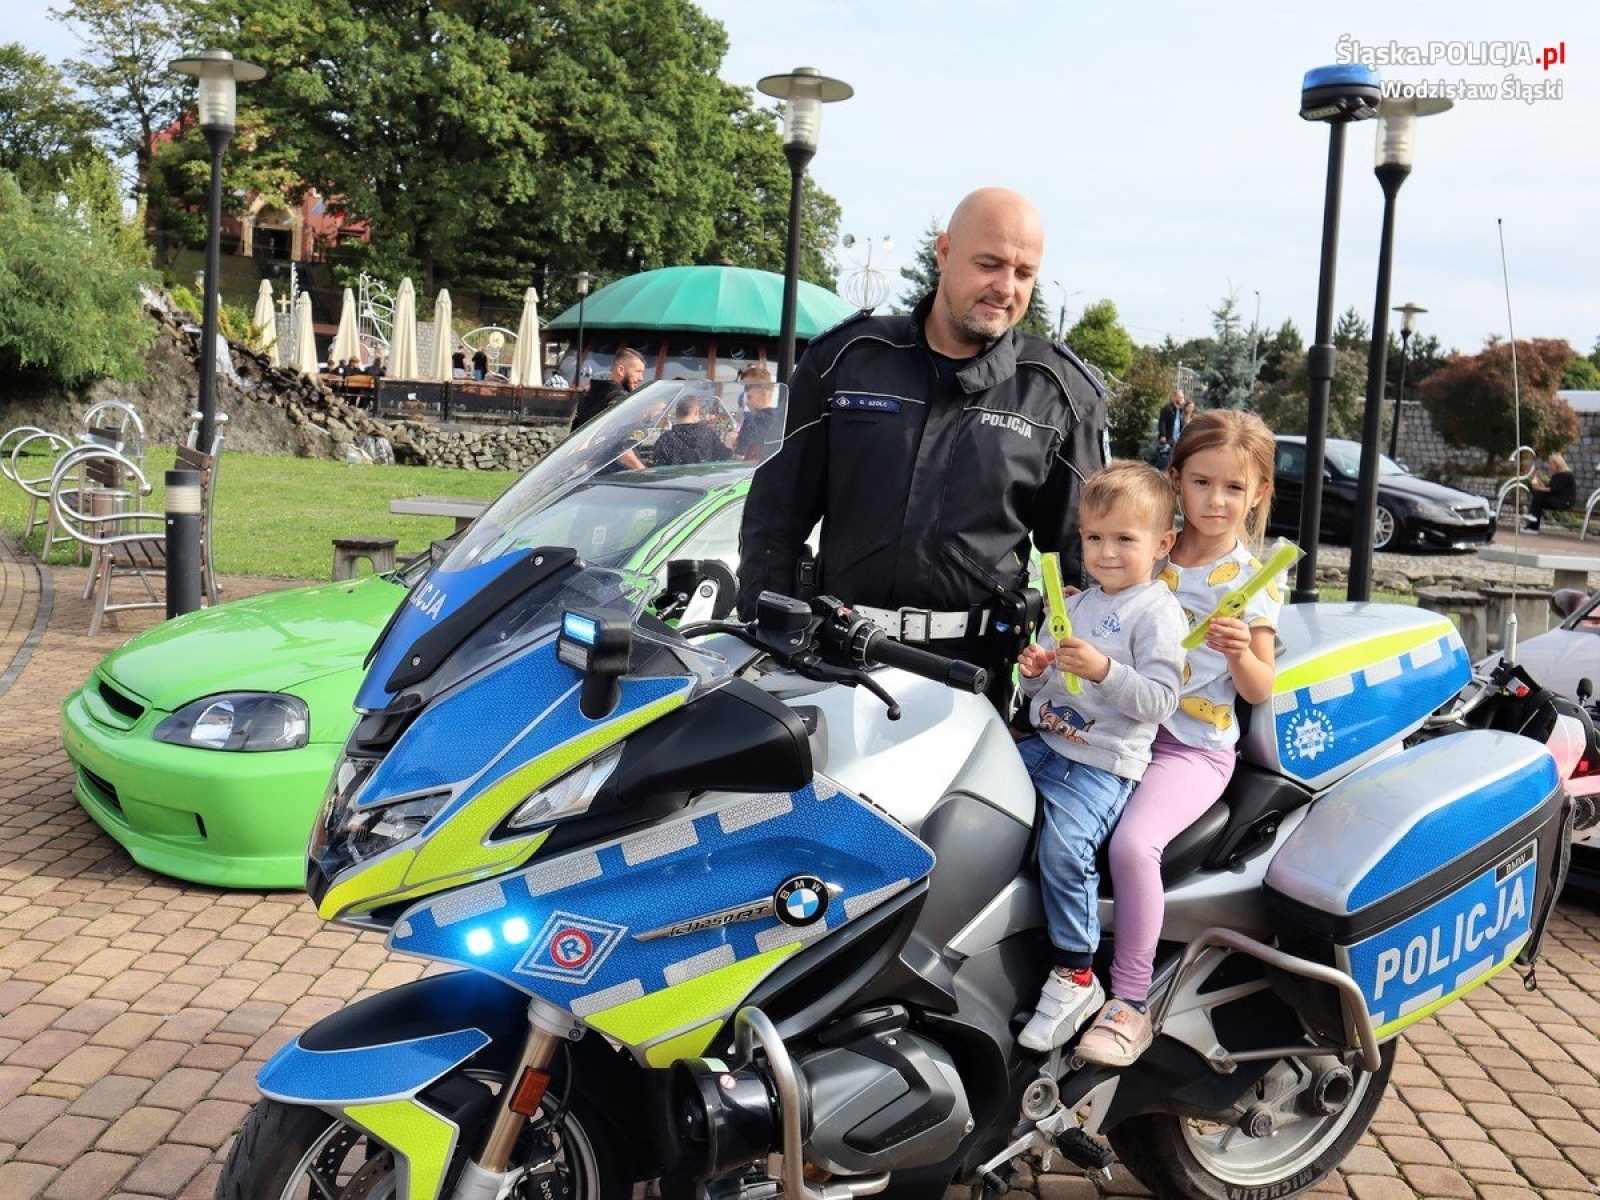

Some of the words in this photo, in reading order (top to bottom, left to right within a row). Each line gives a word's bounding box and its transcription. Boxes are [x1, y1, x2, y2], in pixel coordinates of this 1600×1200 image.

[980, 412, 1032, 439] POLICJA
[1506, 852, 1526, 875] BMW
[779, 879, 822, 901] BMW
[559, 937, 585, 961] R
[1374, 876, 1525, 1001] POLICJA
[1230, 1167, 1313, 1200] MICHELIN
